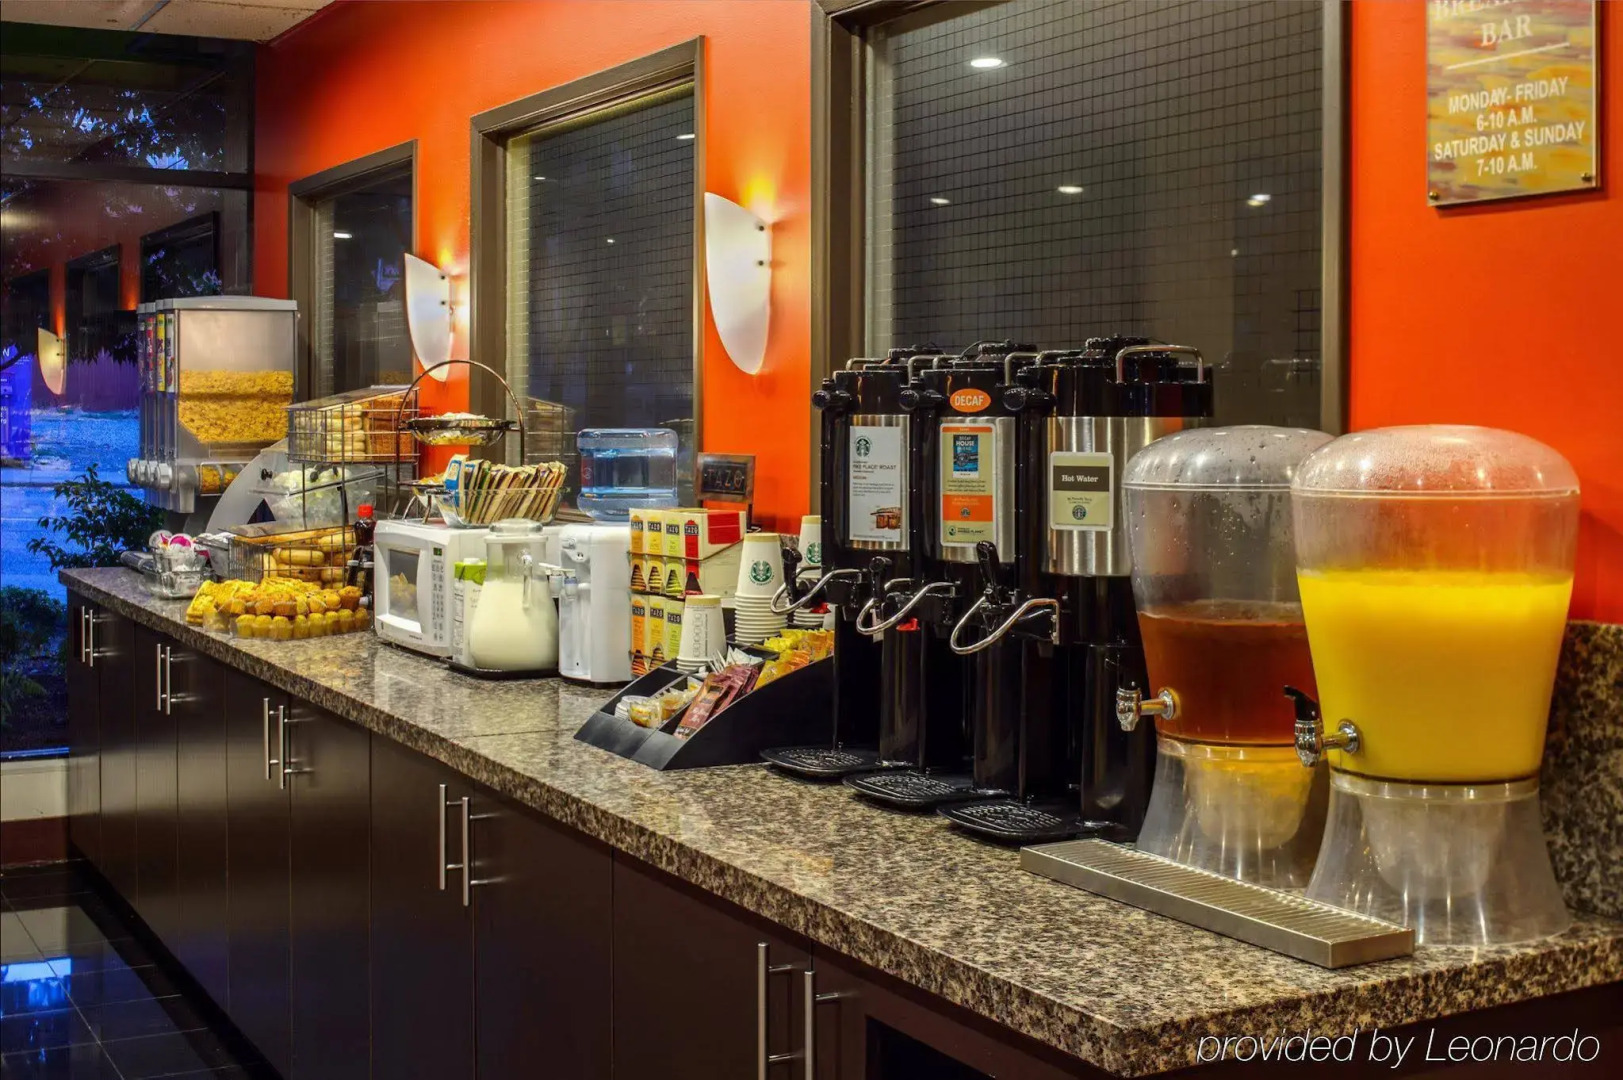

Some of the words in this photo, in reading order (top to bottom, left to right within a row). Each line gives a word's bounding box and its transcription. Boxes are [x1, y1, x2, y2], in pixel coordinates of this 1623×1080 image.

[1480, 14, 1533, 47] BAR
[1515, 76, 1568, 102] FRIDAY
[1476, 111, 1504, 132] 6-10
[1507, 105, 1538, 127] A.M.
[1434, 133, 1507, 160] SATURDAY
[1510, 131, 1521, 149] &
[1524, 121, 1586, 147] SUNDAY
[1476, 156, 1505, 177] 7-10
[1507, 152, 1538, 172] A.M.
[954, 395, 985, 406] DECAF
[1061, 474, 1075, 482] Hot
[1076, 474, 1099, 482] Water
[666, 524, 679, 534] TAZO
[685, 525, 698, 534] TAZO
[650, 607, 663, 617] TAZO
[668, 612, 681, 622] TAZO
